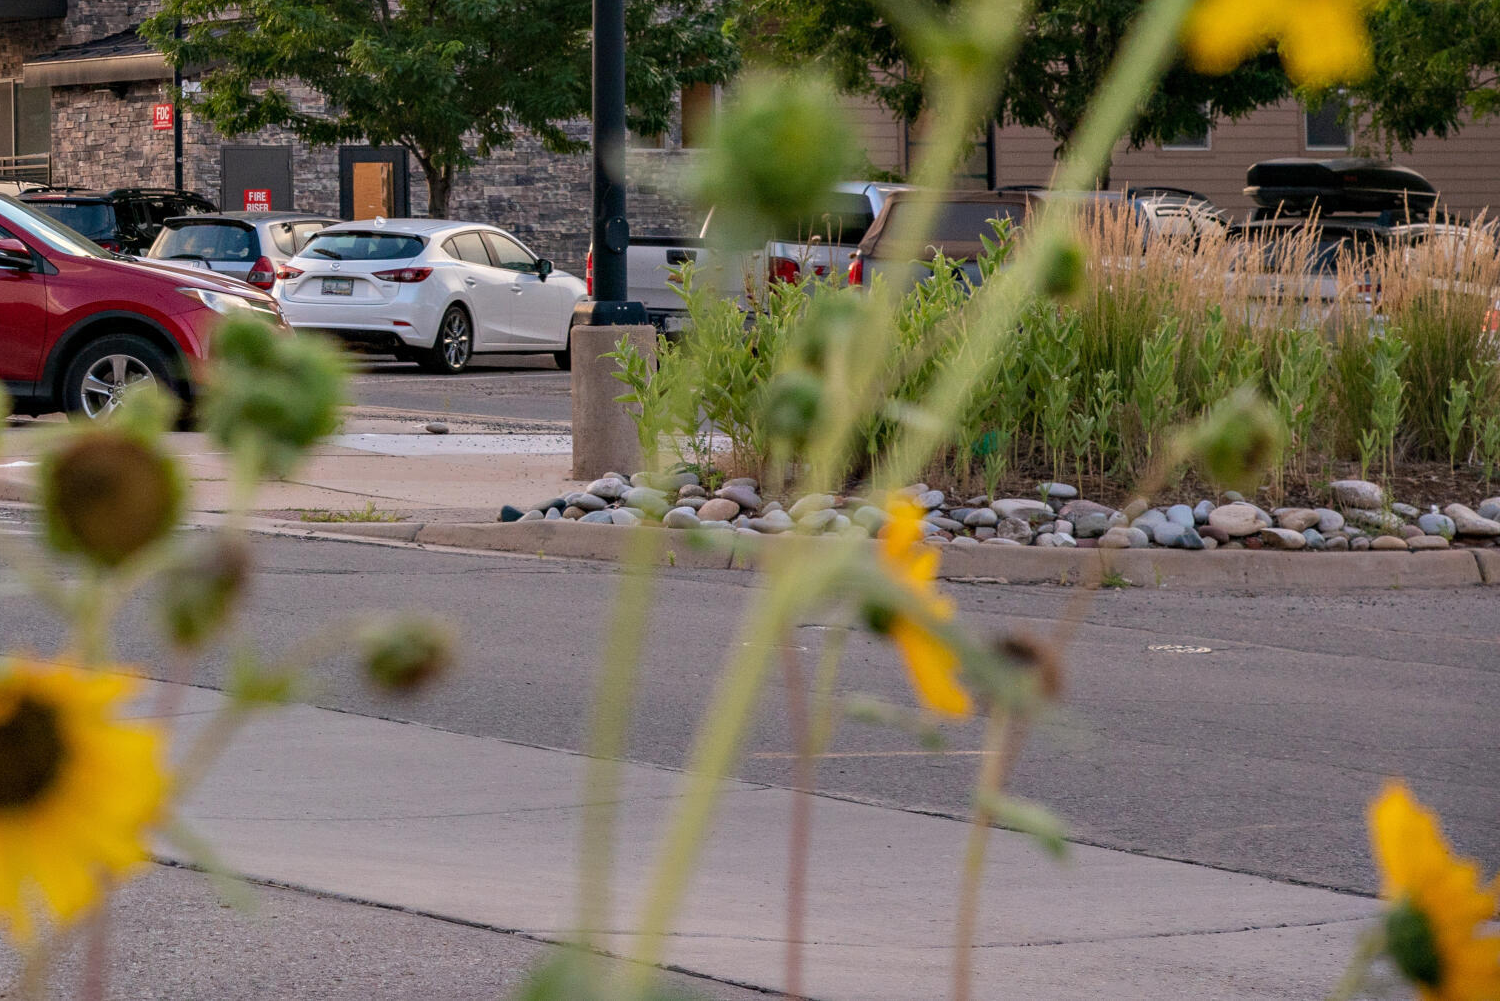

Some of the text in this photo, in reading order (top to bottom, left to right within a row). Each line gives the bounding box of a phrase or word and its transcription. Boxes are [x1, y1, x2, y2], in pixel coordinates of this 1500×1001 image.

[156, 106, 170, 120] FDC
[248, 192, 267, 202] FIRE
[246, 203, 269, 212] RISER
